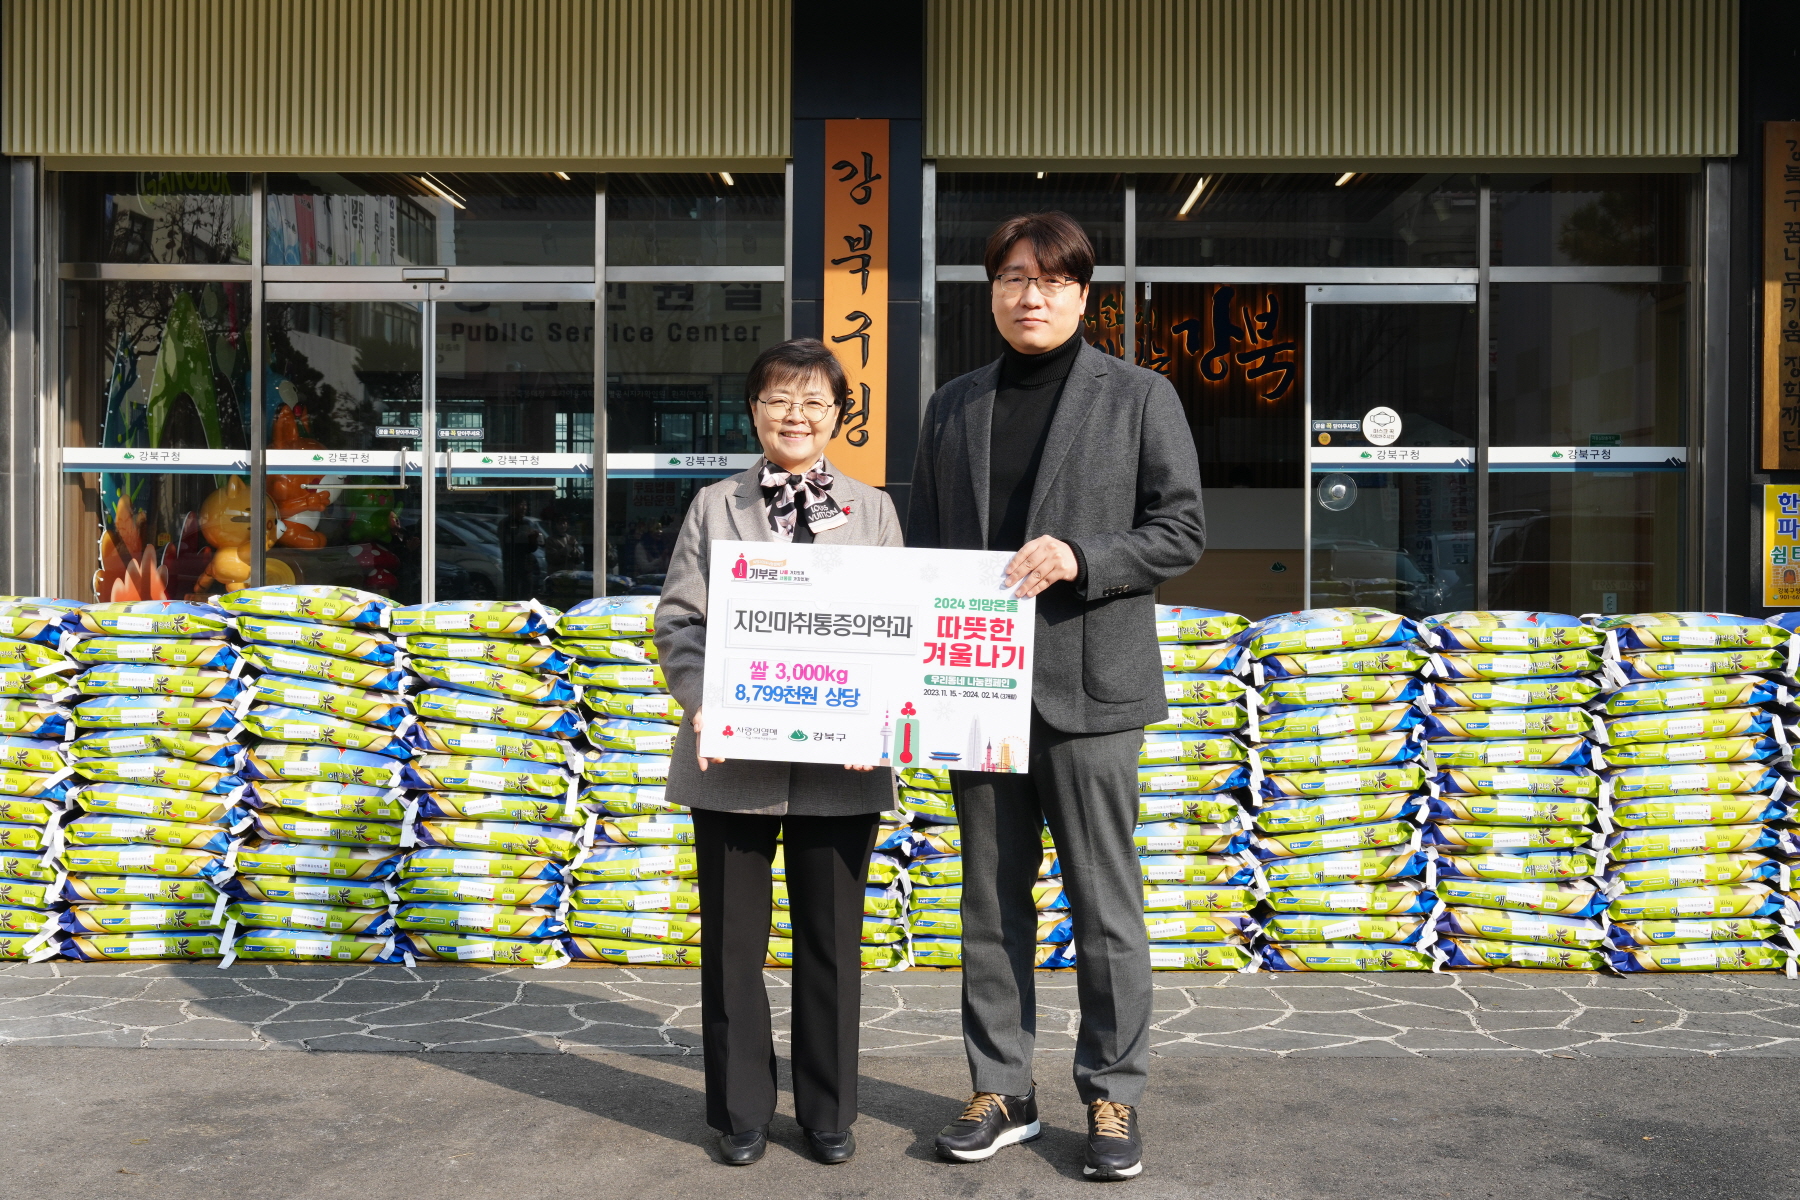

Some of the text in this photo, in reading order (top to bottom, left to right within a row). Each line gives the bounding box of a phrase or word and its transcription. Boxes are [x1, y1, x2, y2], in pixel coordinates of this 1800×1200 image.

[832, 151, 882, 447] 강북구청
[452, 322, 762, 342] Public Serice Center
[1171, 286, 1296, 400] 강북
[139, 450, 180, 462] 강북구청
[328, 452, 370, 464] 강북구청
[498, 456, 540, 465] 강북구청
[686, 456, 728, 466] 강북구청
[1377, 450, 1420, 460] 강북구청
[1568, 450, 1611, 460] 강북구청
[809, 507, 838, 521] VUITTON
[810, 505, 829, 513] LOUIS
[749, 568, 778, 580] 기부로
[934, 598, 1018, 612] 2024 희망온돌
[734, 610, 913, 638] 지인마취통증의학과
[937, 616, 1014, 642] 따뜻한
[923, 642, 1024, 670] 겨울나기
[750, 661, 848, 684] 쌀 3,000kg
[931, 676, 1010, 688] 우리동네 나눔캠페인
[735, 684, 861, 708] 8,799천원 상당
[813, 732, 846, 741] 강북구
